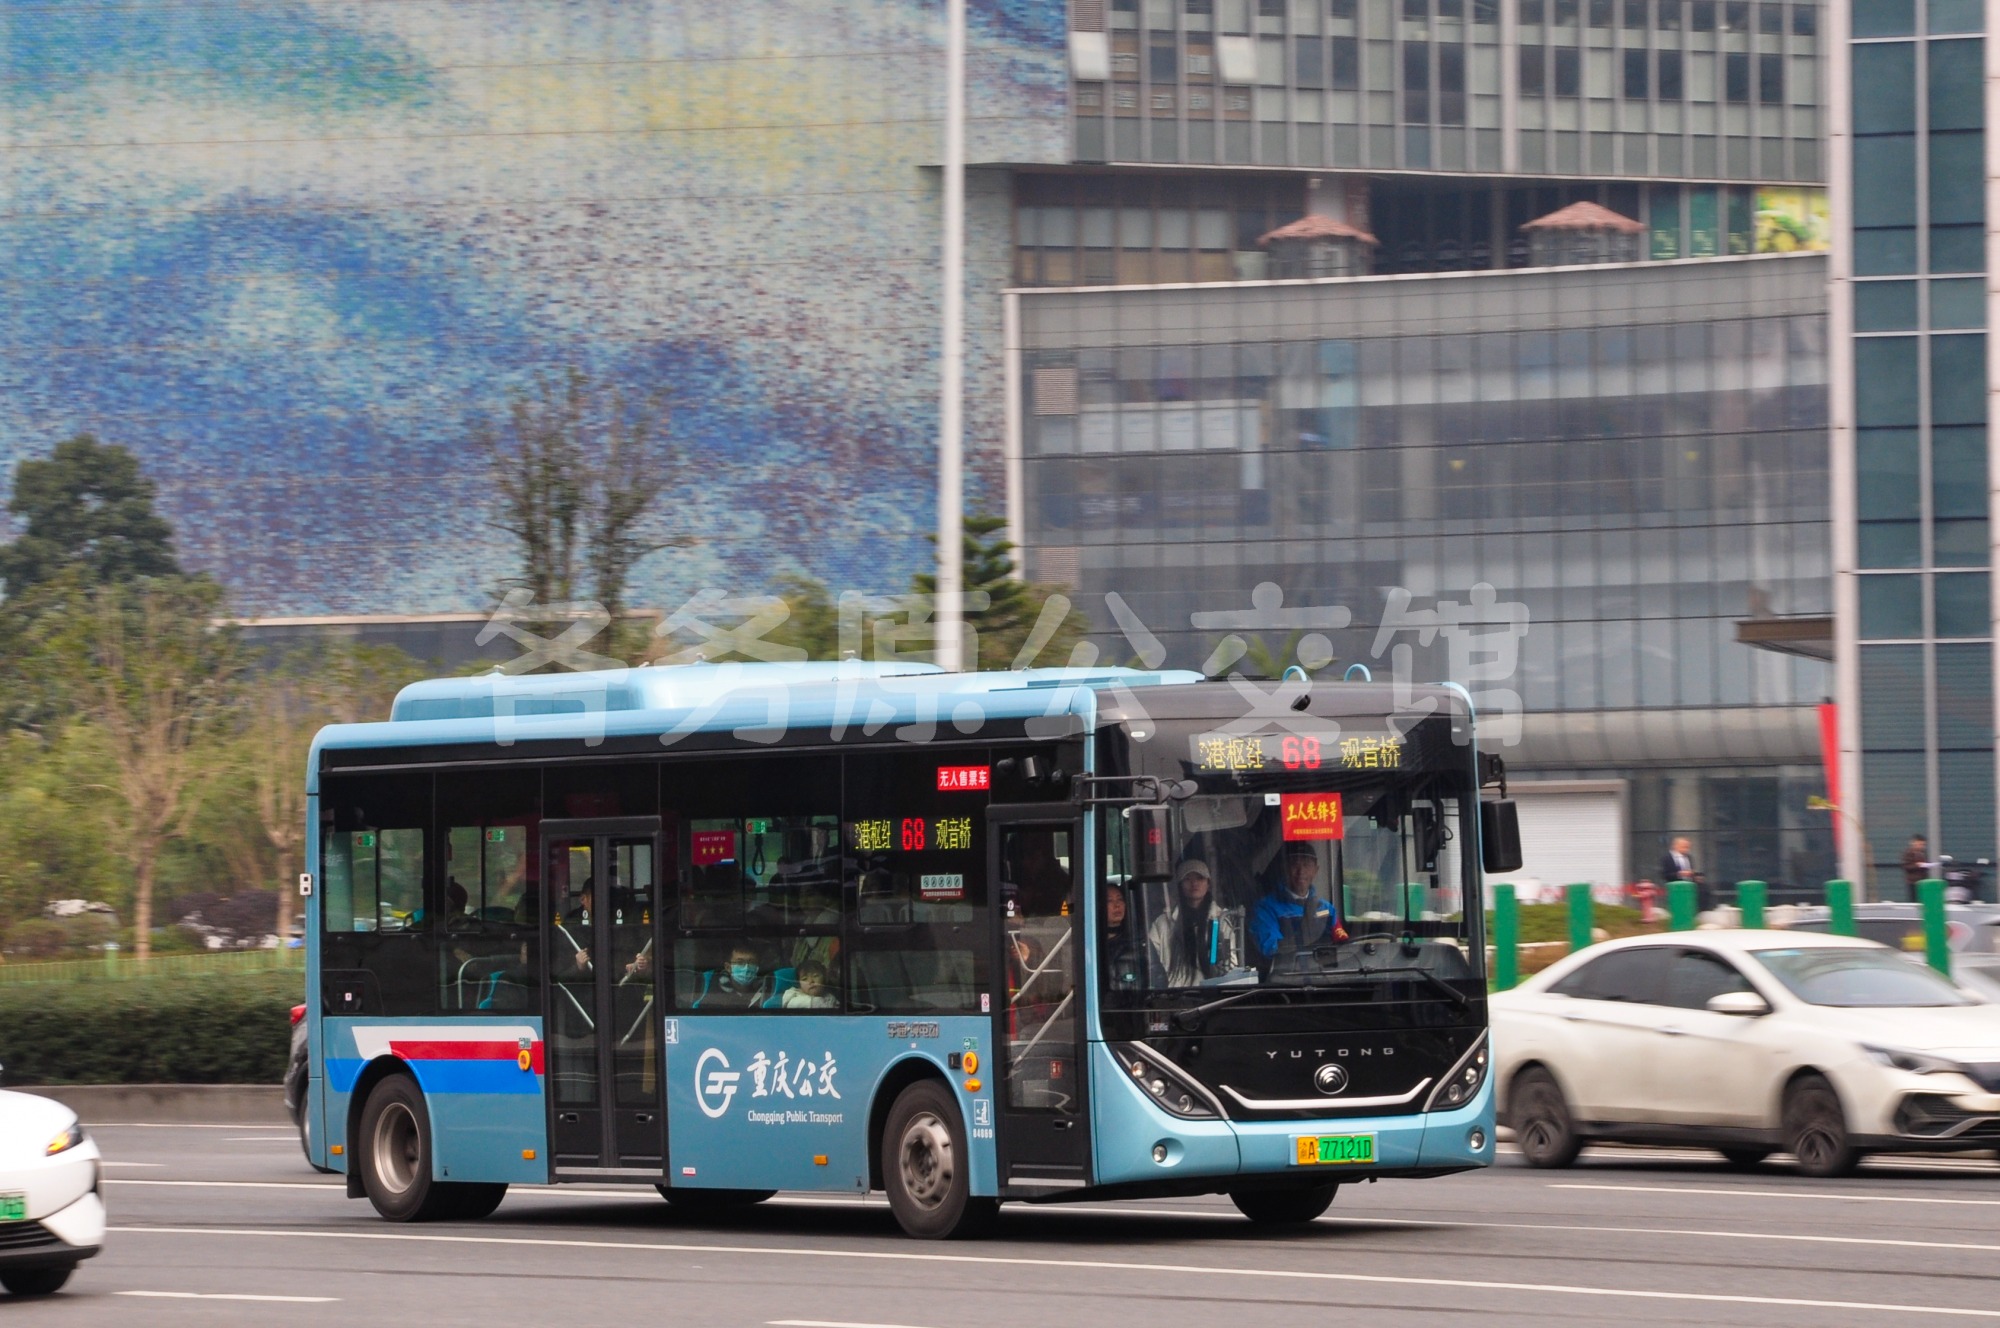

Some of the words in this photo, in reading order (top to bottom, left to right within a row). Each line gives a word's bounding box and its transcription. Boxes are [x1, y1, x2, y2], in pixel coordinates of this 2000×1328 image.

[1282, 736, 1321, 769] 68
[1339, 736, 1401, 769] 观音桥
[939, 769, 988, 787] 无人售票车
[1286, 800, 1338, 823] 工人先锋号
[901, 817, 926, 851] 68
[935, 817, 972, 850] 观音桥
[1266, 1047, 1395, 1059] YUTONG
[746, 1050, 842, 1100] 重庆公交
[747, 1109, 786, 1125] Chongqing
[786, 1110, 808, 1123] Public
[809, 1111, 844, 1126] Transport
